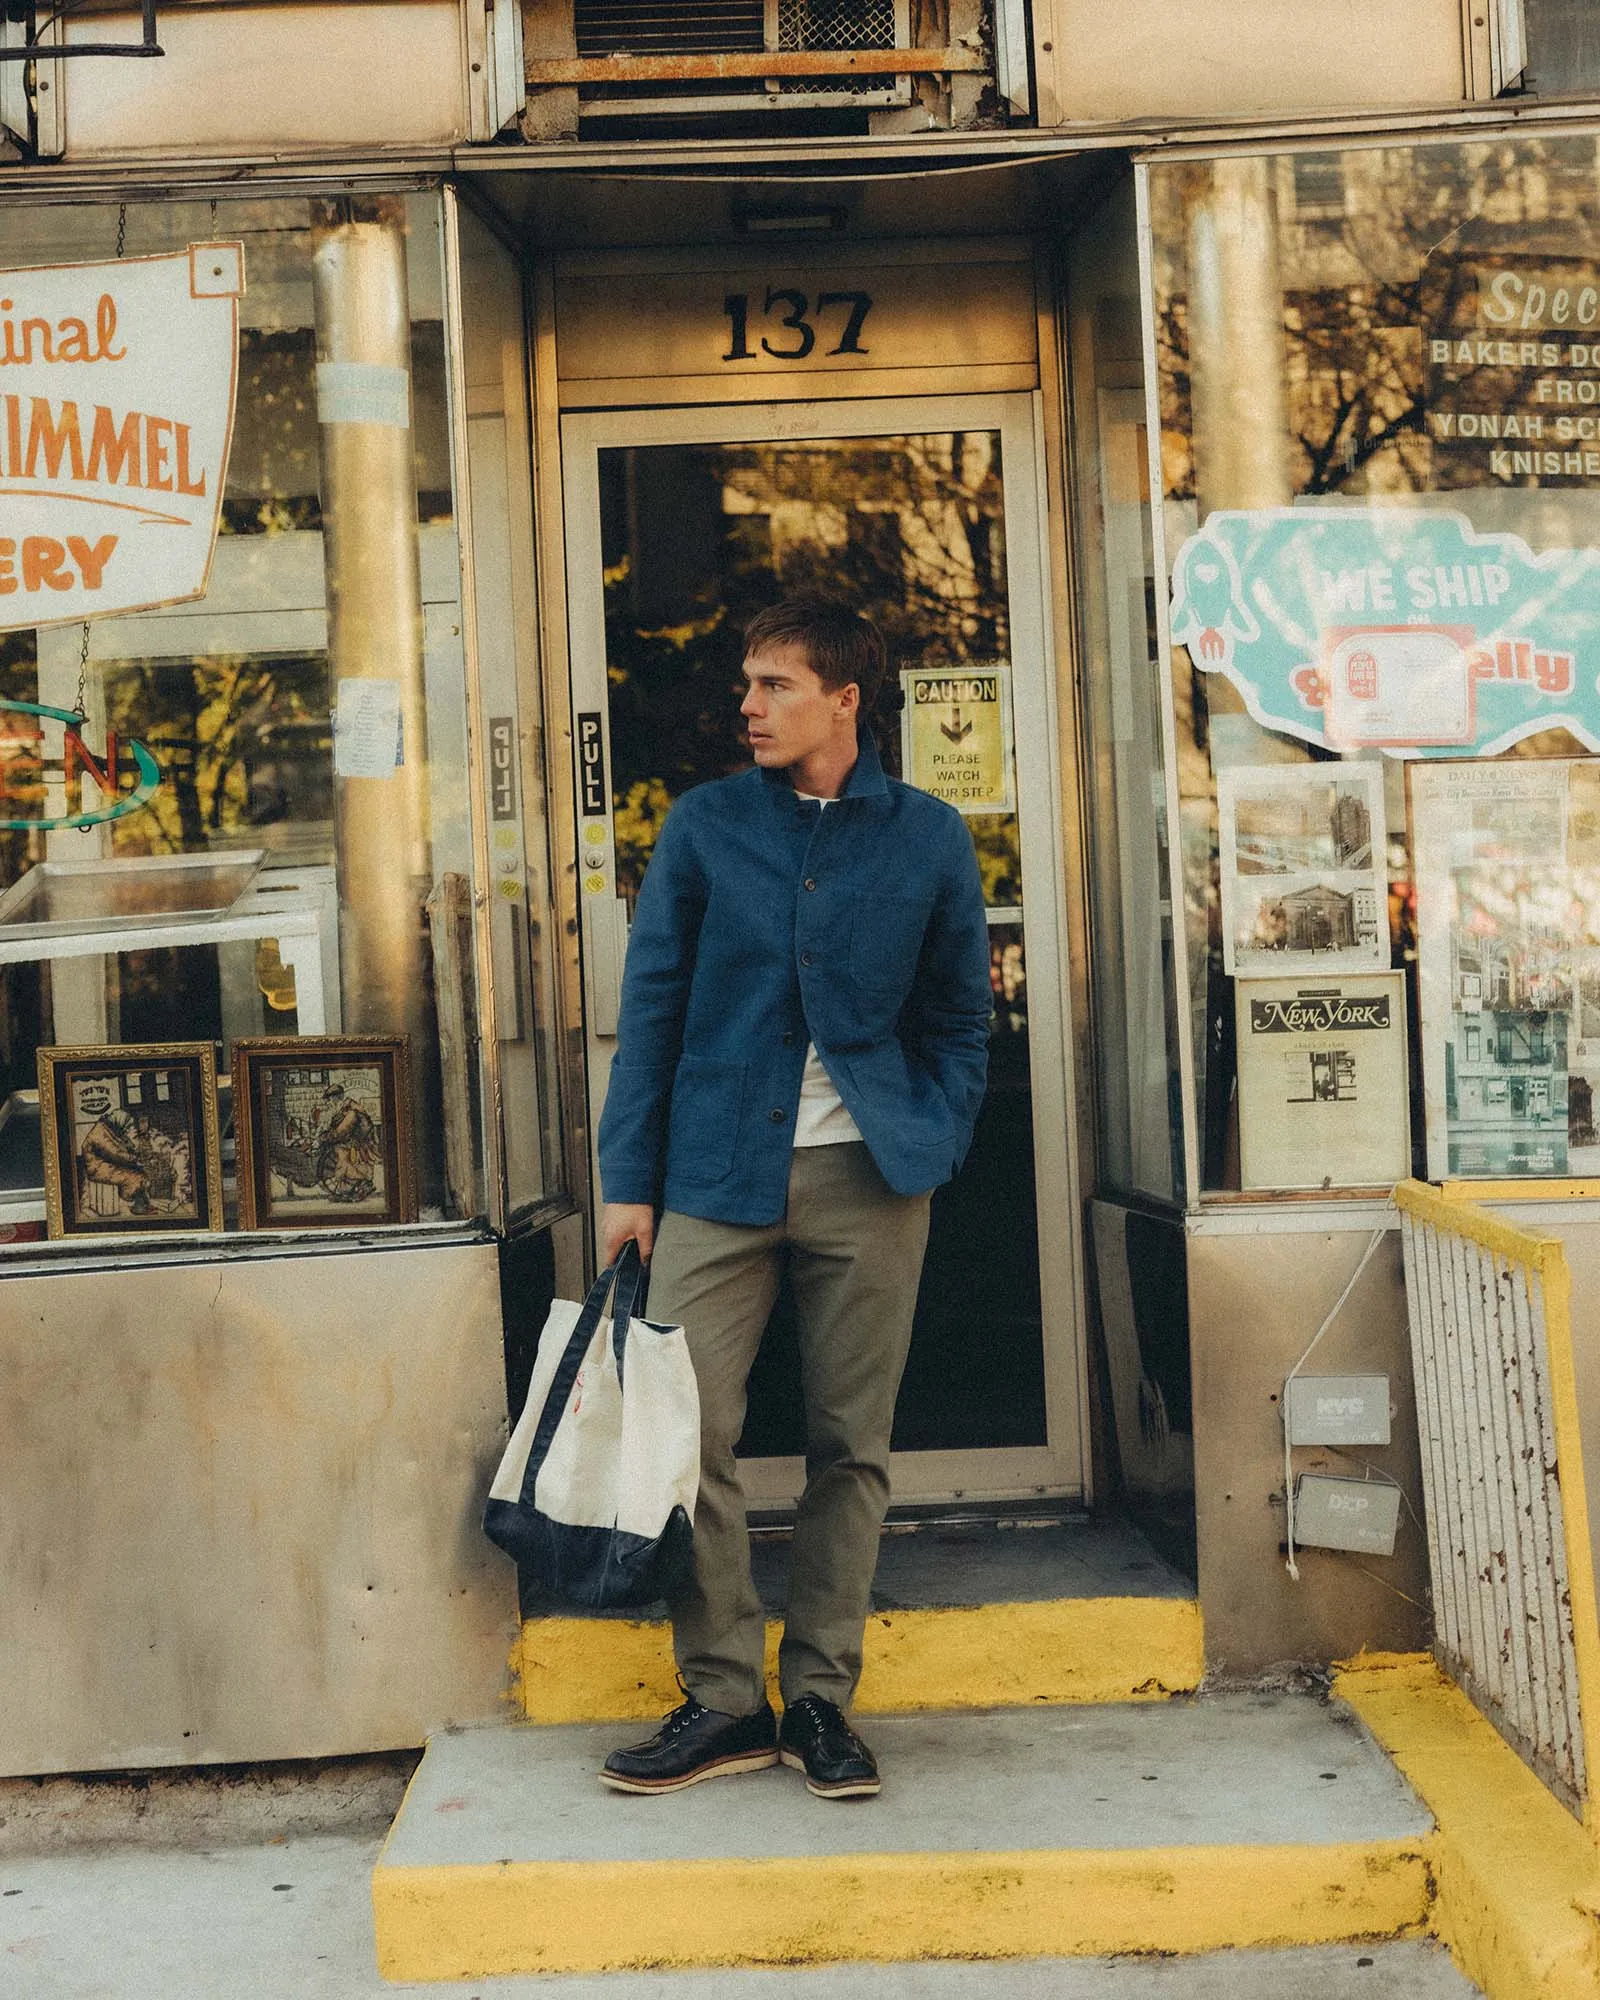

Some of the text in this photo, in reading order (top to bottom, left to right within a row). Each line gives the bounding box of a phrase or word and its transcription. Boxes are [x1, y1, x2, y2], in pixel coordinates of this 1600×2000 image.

[1483, 271, 1598, 329] Spec
[722, 286, 873, 361] 137
[1431, 340, 1560, 366] BAKERS
[1537, 380, 1600, 403] FRO
[1438, 415, 1600, 440] YONAH SC
[0, 394, 206, 497] IMMEL
[1490, 450, 1597, 475] KNISHE
[1321, 564, 1510, 612] WE SHIP
[915, 679, 996, 703] CAUTION
[582, 721, 600, 808] PULL
[933, 754, 981, 765] PLEASE
[936, 770, 980, 781] WATCH
[962, 786, 994, 798] STEP
